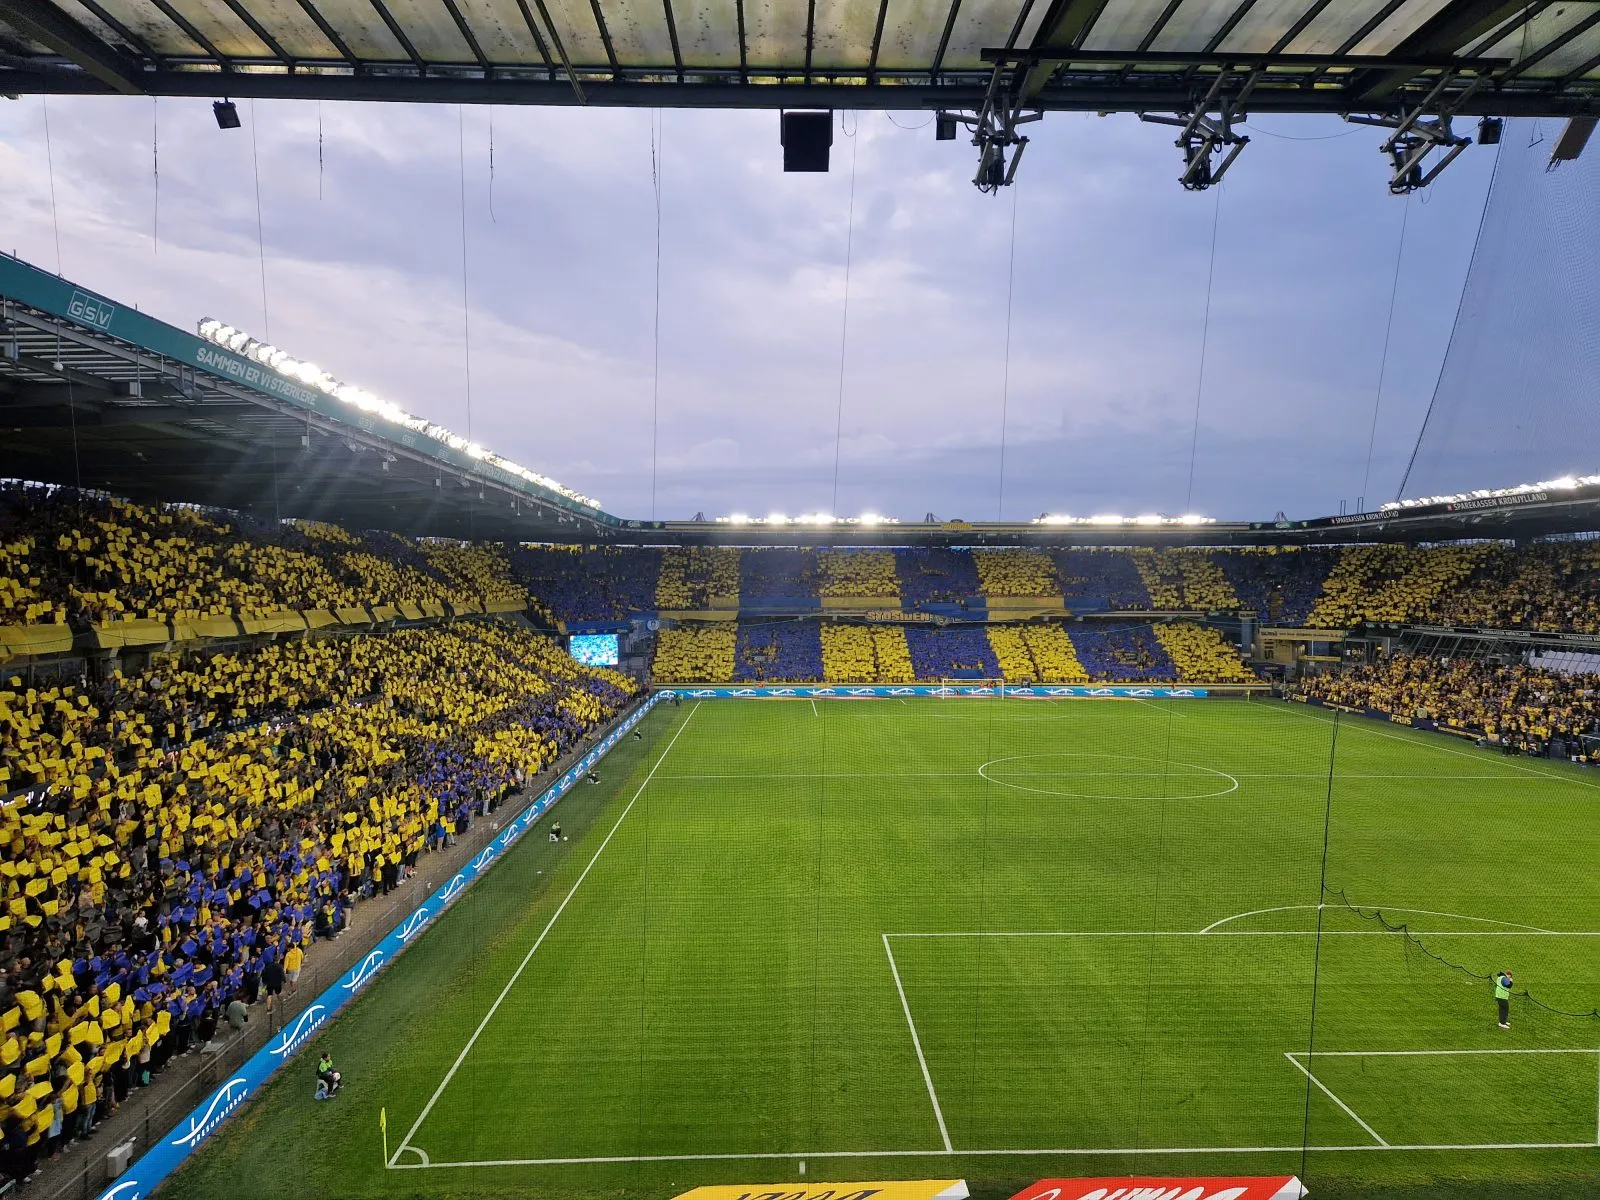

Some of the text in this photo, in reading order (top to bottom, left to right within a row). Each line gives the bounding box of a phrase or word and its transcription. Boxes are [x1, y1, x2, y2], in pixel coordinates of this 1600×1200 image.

[69, 300, 111, 325] GSV
[197, 347, 246, 378] SAMMEN
[244, 366, 260, 384] ER
[261, 373, 272, 388] VI
[1453, 492, 1548, 511] SPAREKASSEN KRONJYLLAND
